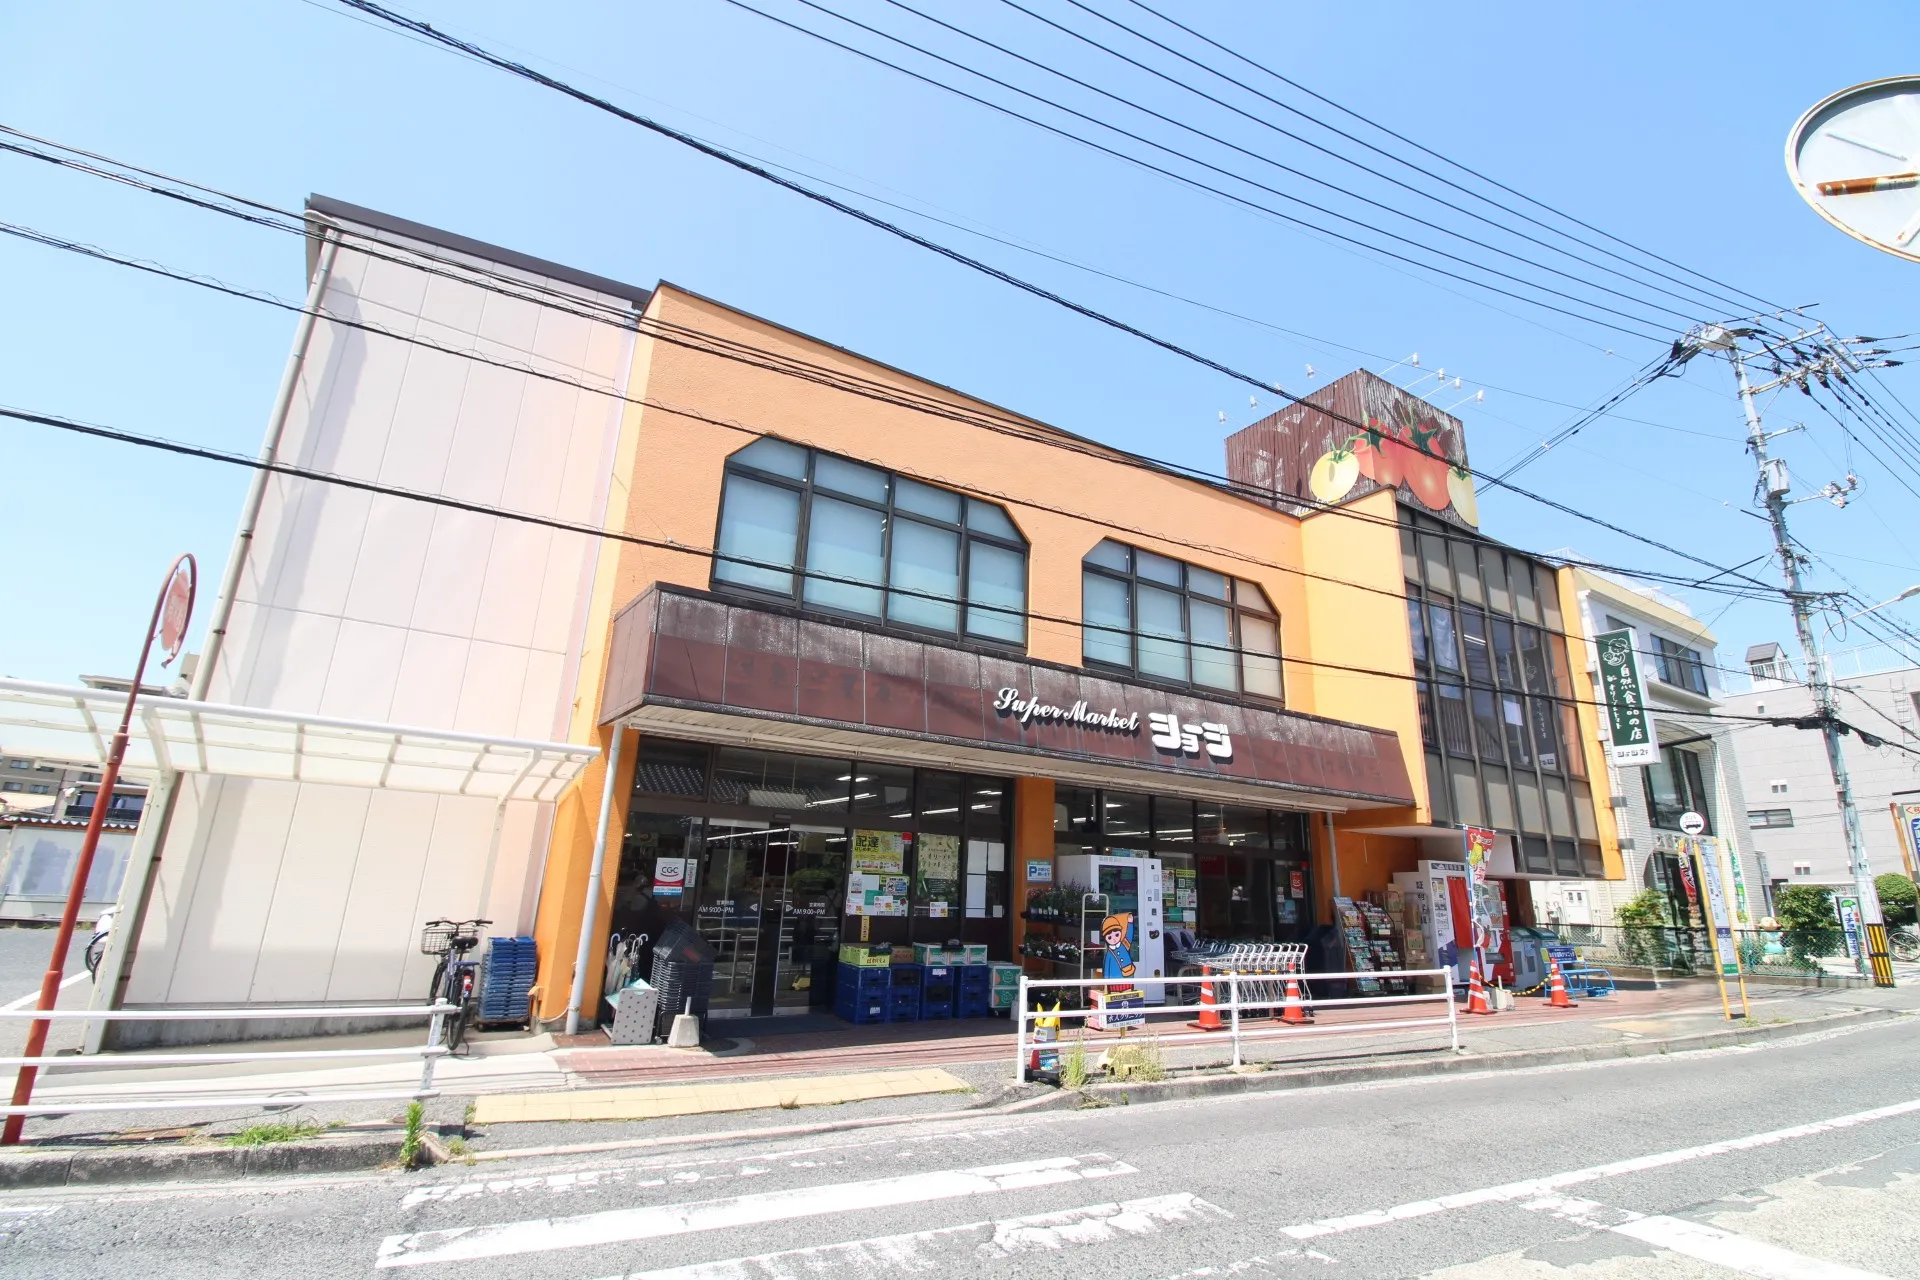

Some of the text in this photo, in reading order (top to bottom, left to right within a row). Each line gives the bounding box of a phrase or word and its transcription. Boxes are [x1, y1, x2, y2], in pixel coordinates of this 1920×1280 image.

[993, 687, 1140, 731] Super Market
[1620, 663, 1643, 741] 自然食品の店
[1148, 712, 1233, 758] ショジ
[855, 834, 879, 848] 配達
[661, 866, 679, 874] CGC
[1028, 865, 1038, 877] P
